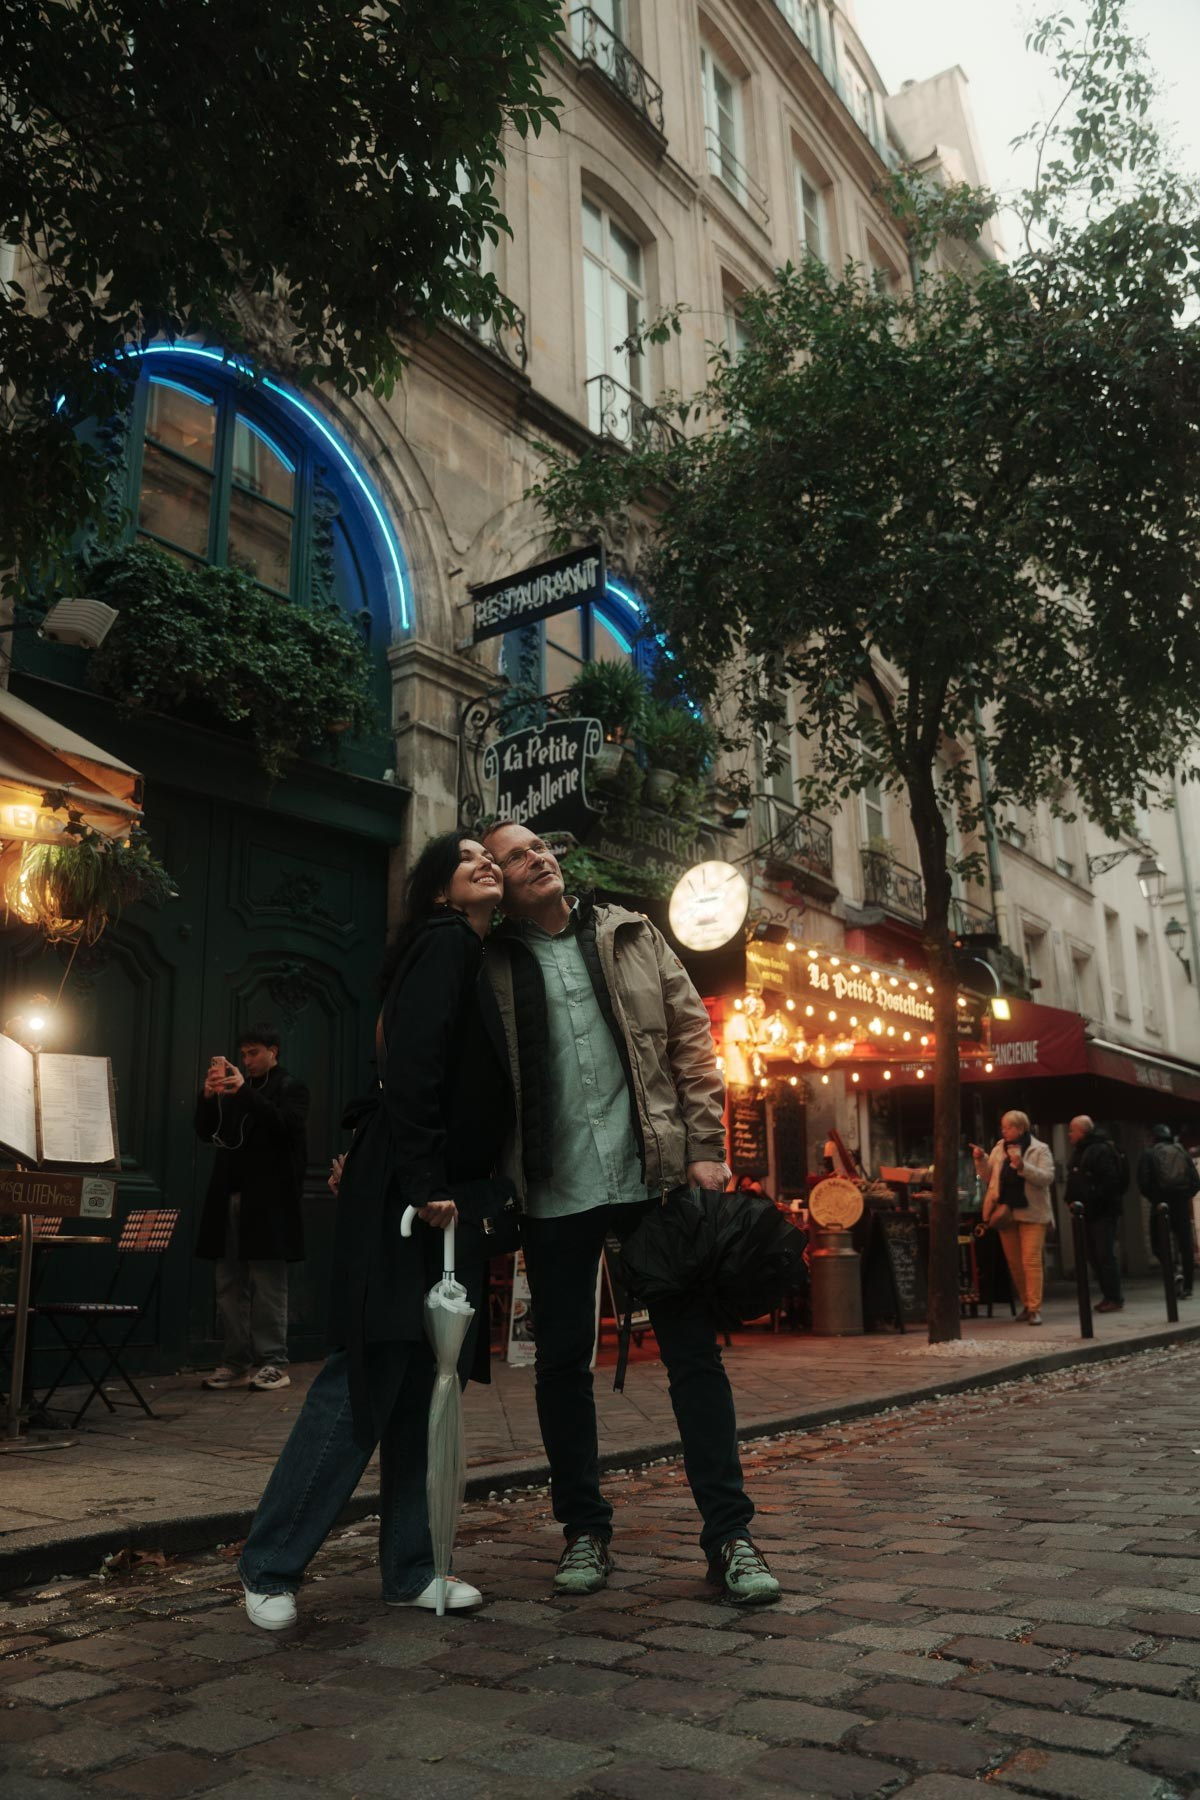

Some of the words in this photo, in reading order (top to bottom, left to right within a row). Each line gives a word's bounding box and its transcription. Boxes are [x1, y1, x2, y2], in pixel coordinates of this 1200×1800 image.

[473, 557, 599, 629] RESTAURANT
[503, 743, 523, 772] La
[526, 734, 578, 768] Petite
[498, 767, 579, 825] Hostellerie
[807, 962, 830, 991] La
[832, 972, 873, 1003] Petite
[875, 986, 935, 1022] Hostellerie
[12, 1182, 56, 1206] GLUTEN
